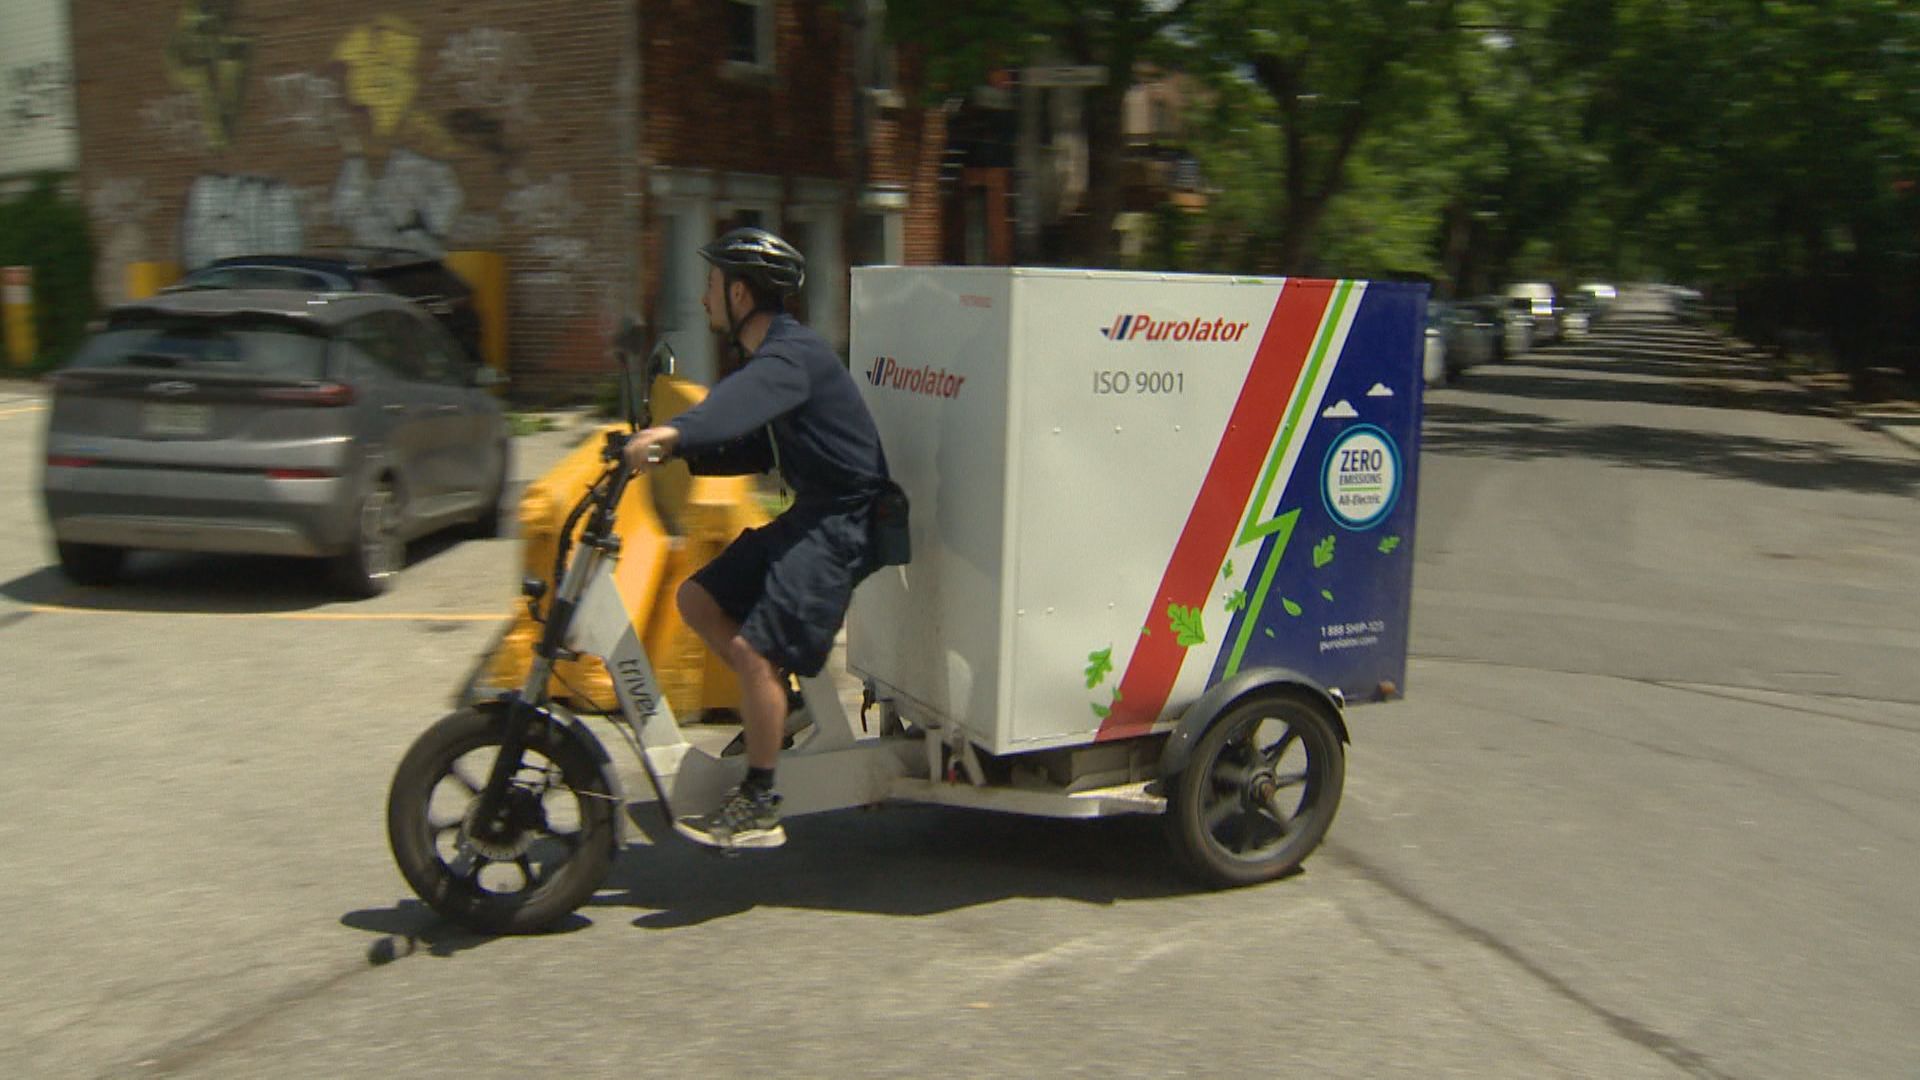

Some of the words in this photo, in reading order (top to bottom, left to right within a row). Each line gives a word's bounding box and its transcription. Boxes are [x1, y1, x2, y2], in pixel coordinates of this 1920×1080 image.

[1128, 314, 1249, 342] Purolator
[882, 356, 965, 399] Purolator
[1093, 370, 1130, 394] ISO
[1135, 370, 1184, 394] 9001
[1340, 448, 1383, 472] ZERO
[1339, 473, 1382, 486] EMISSIONS
[1320, 626, 1326, 638] 1
[1327, 624, 1345, 637] 888
